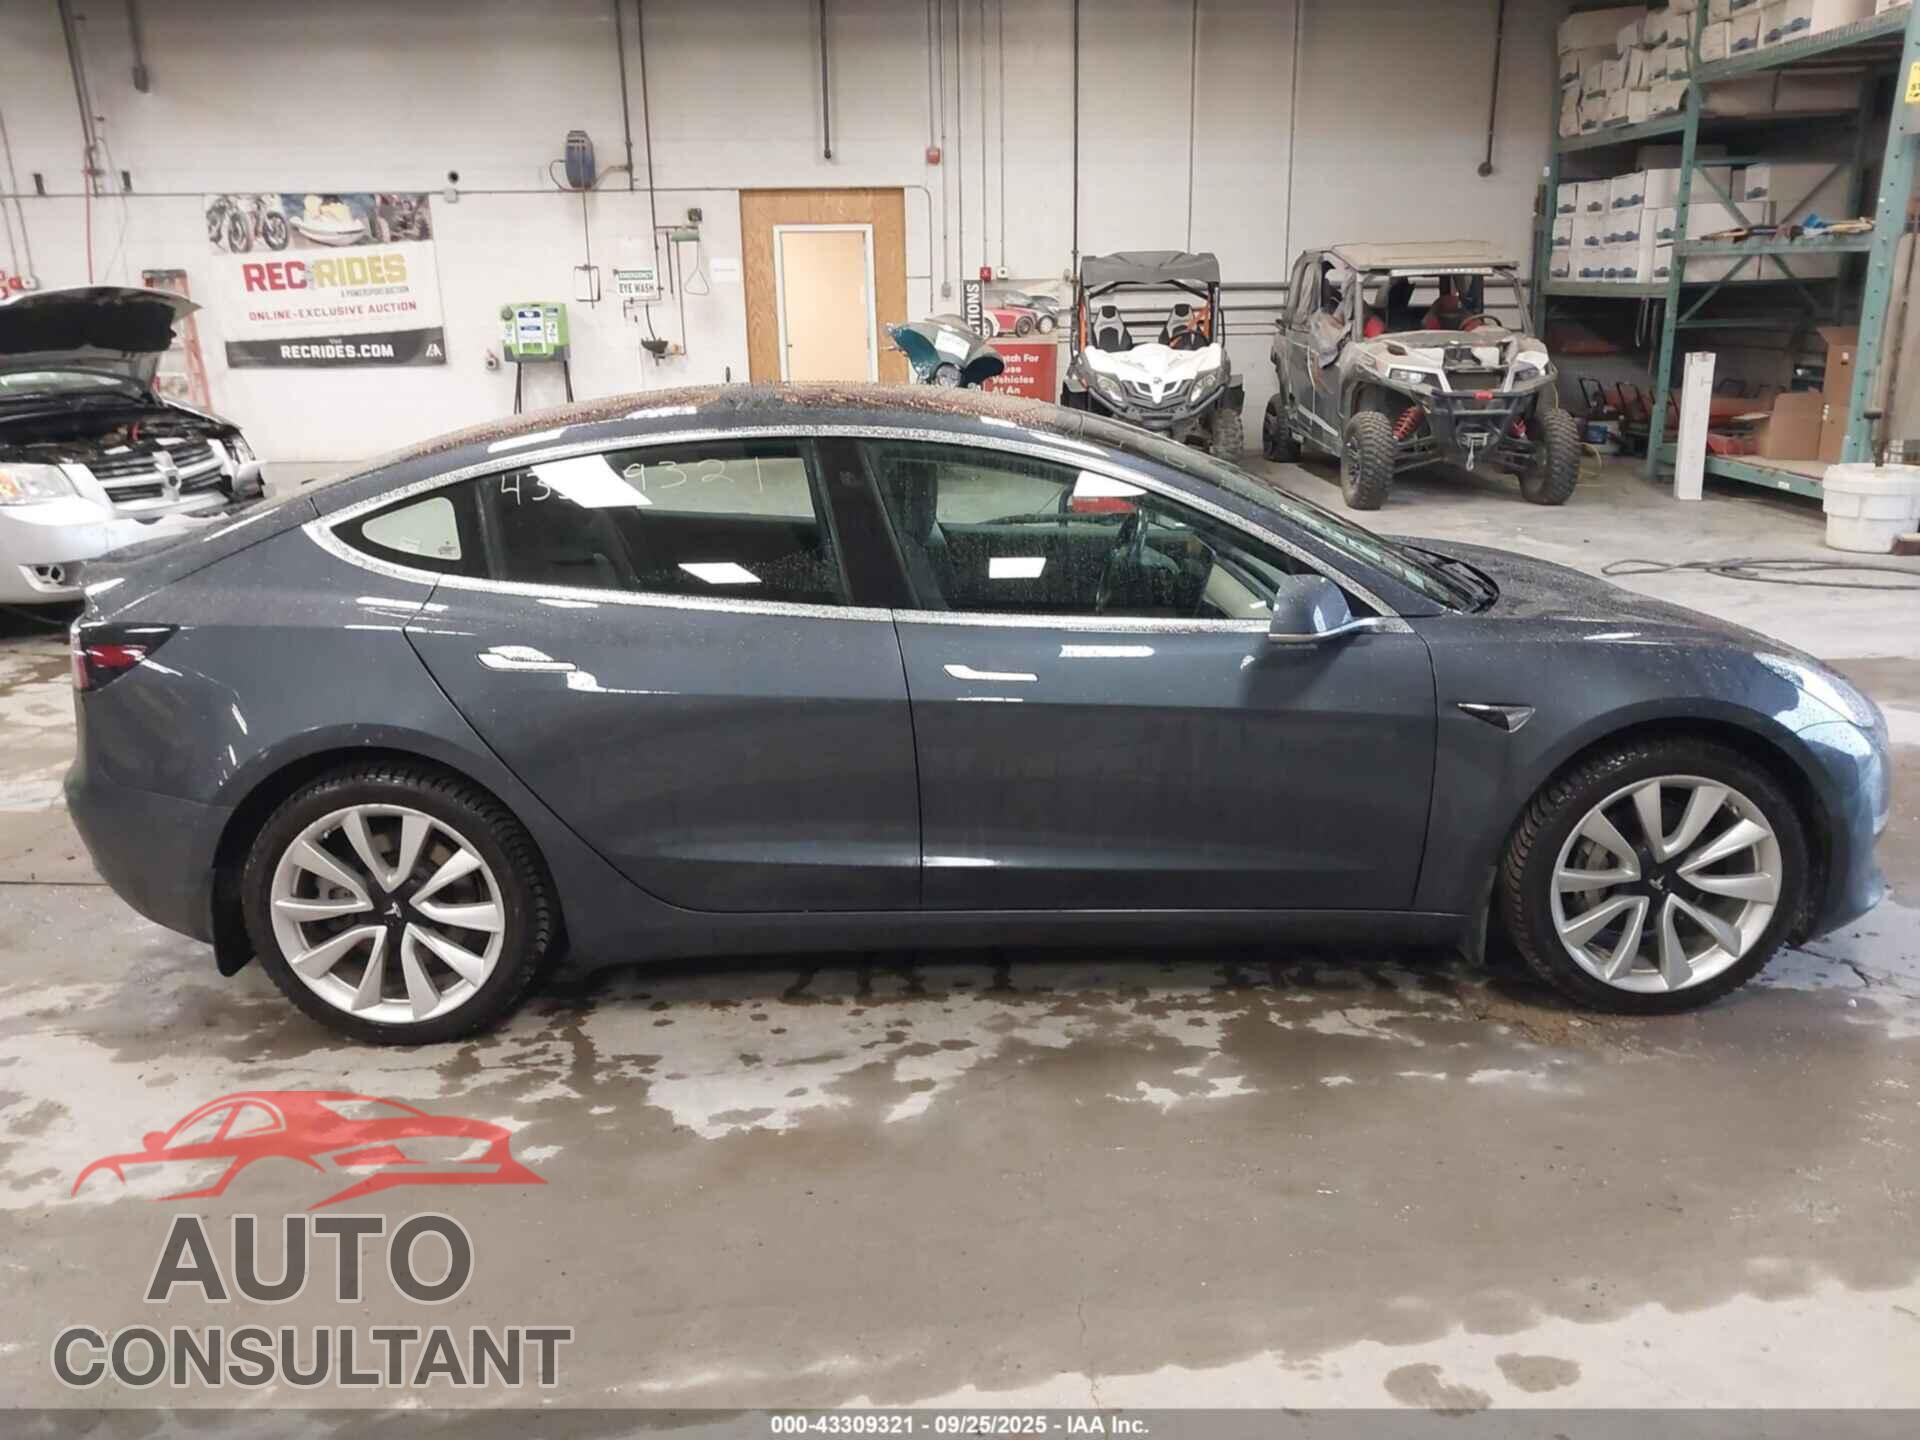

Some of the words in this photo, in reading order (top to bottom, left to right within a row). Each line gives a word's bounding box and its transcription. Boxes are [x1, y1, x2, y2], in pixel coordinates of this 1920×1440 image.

[242, 261, 307, 292] REC
[313, 254, 408, 288] RIDES
[249, 306, 364, 321] ONLINE-EXCLUSIVE
[368, 301, 417, 313] AUCTION
[280, 344, 394, 359] RECRIDES.COM
[1023, 354, 1040, 362] For
[992, 375, 1035, 384] Vehicles
